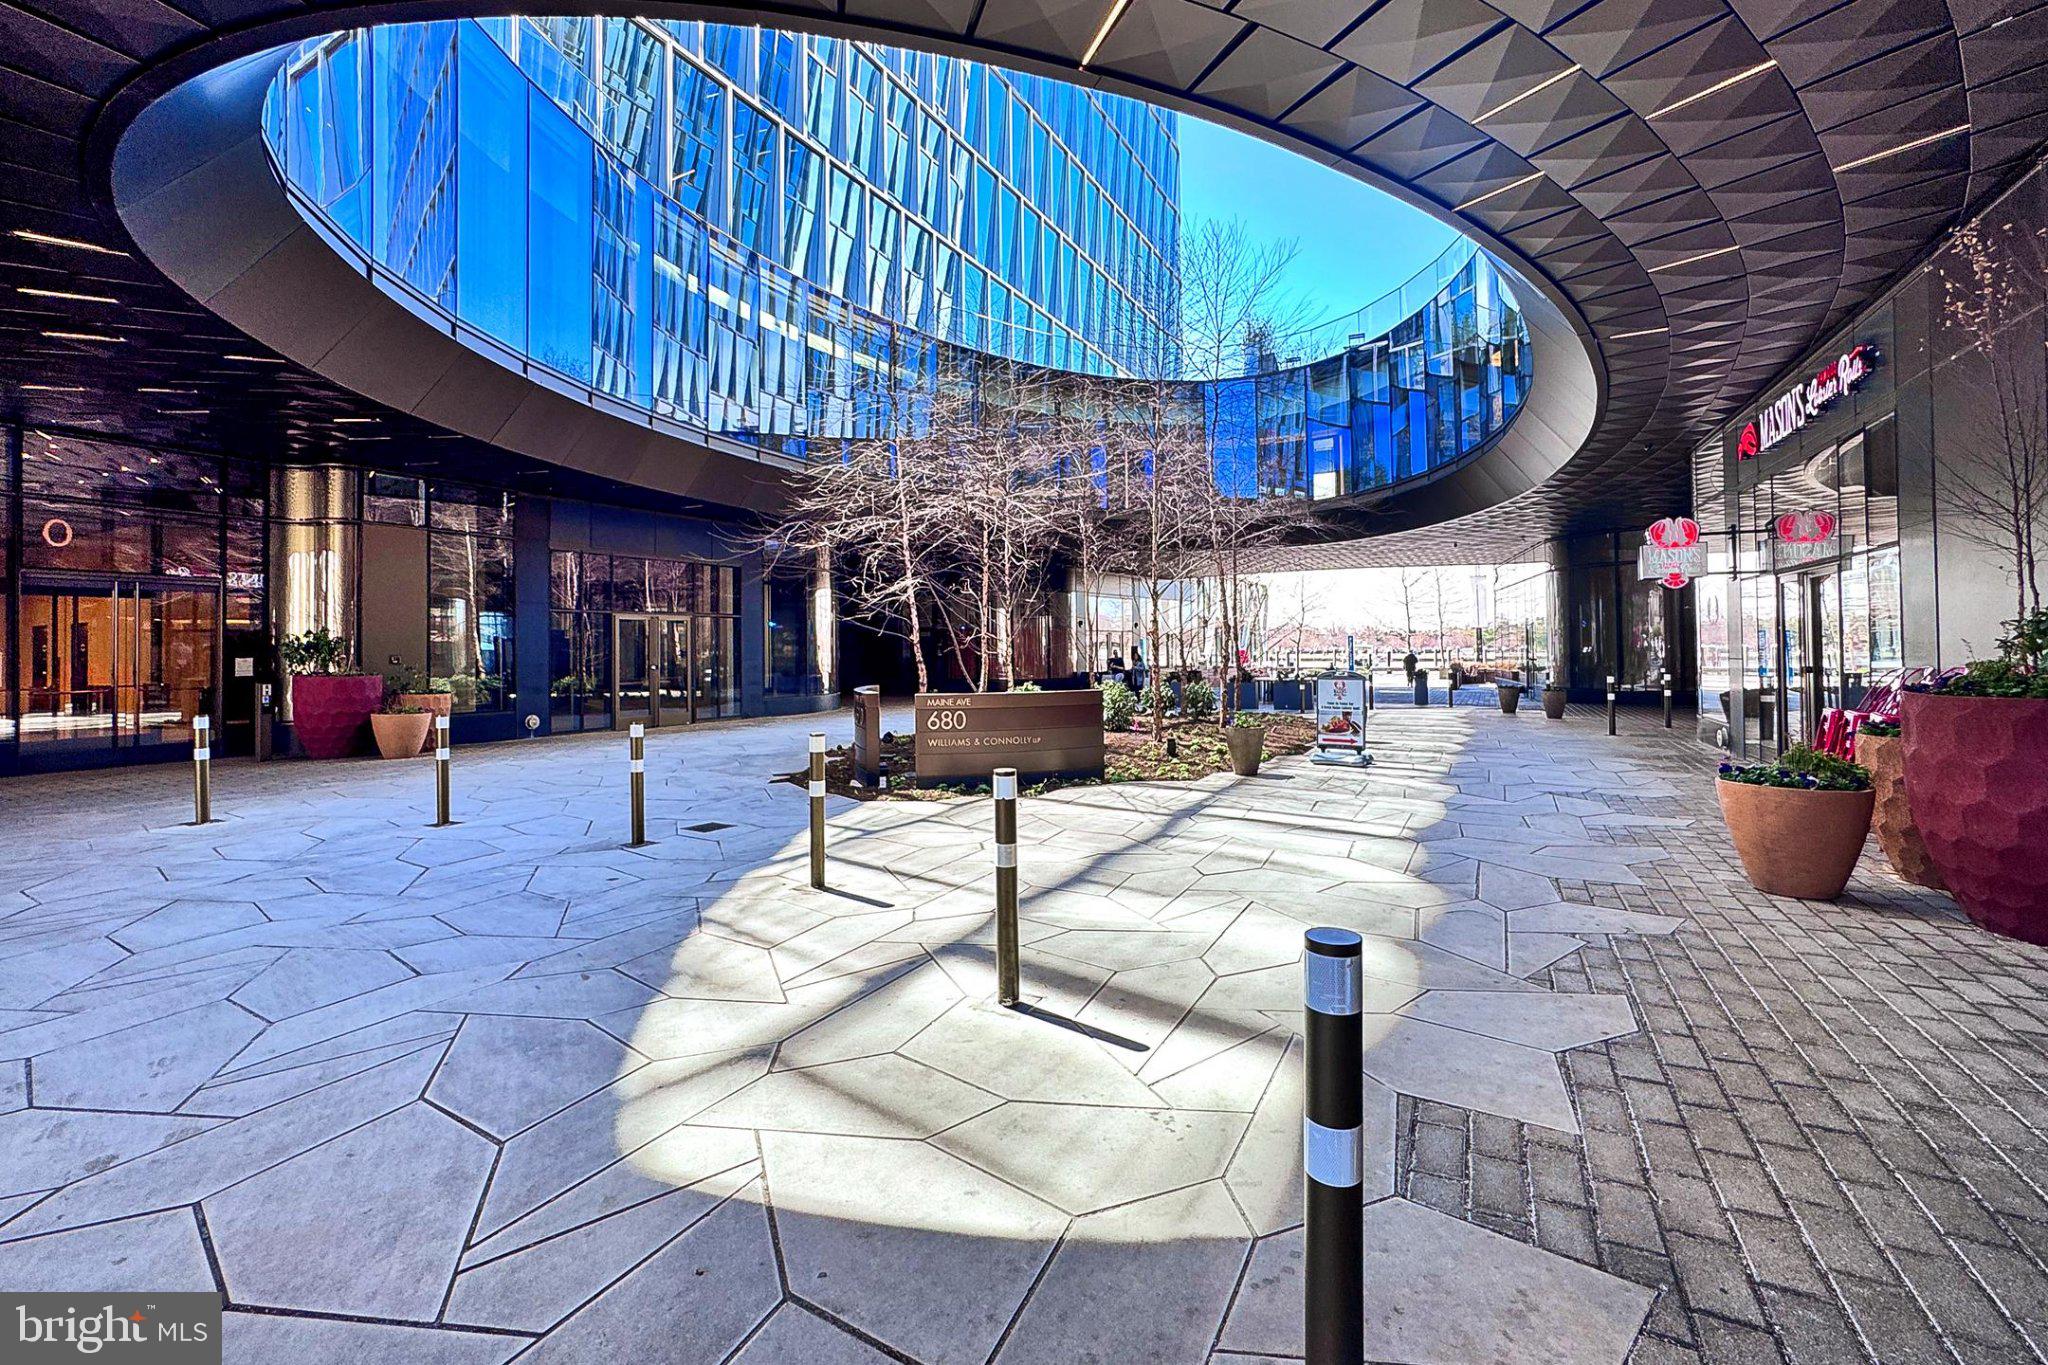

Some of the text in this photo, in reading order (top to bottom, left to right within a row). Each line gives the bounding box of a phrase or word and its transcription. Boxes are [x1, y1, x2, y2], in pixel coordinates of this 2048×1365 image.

[927, 698, 972, 706] MAINE AVE
[927, 710, 967, 730] 680
[928, 738, 971, 747] WILLIAMS
[974, 738, 981, 746] &
[983, 736, 1032, 746] CONNOLLY
